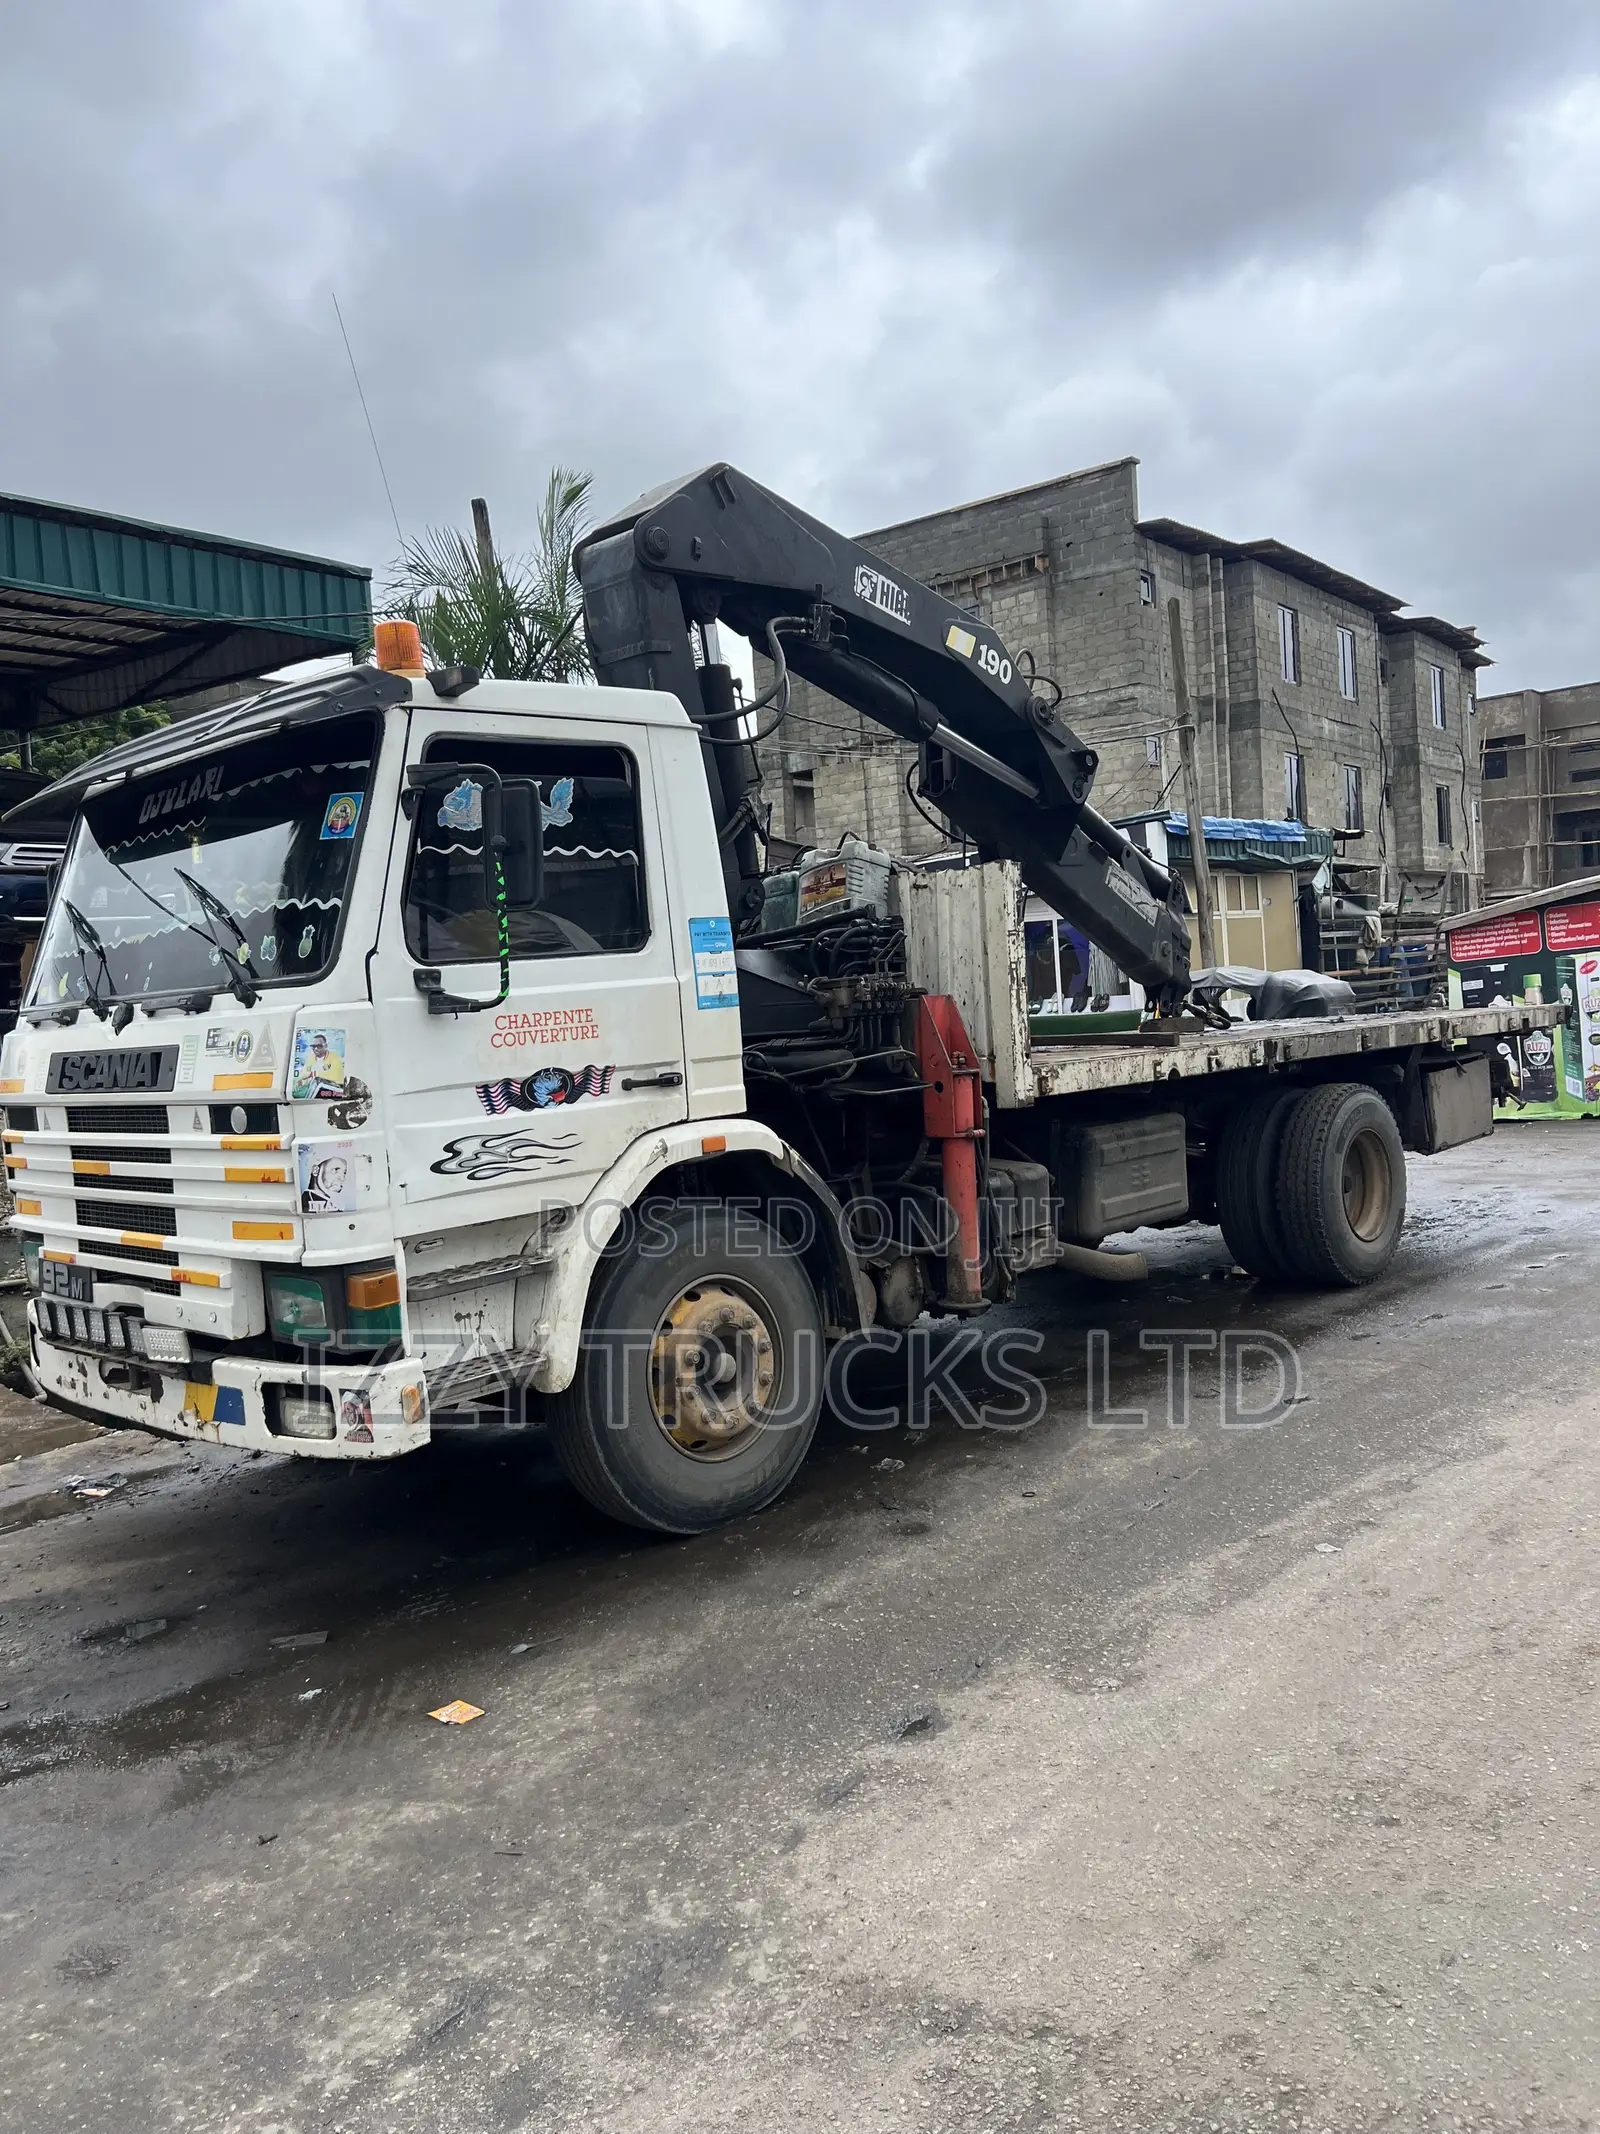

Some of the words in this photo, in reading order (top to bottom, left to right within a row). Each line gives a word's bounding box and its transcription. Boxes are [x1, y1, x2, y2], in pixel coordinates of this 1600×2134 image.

[977, 645, 1012, 684] 190
[495, 1008, 593, 1030] CHARPENTE
[491, 1025, 599, 1048] COUVERTURE
[1526, 1041, 1548, 1052] RUZU
[62, 1051, 155, 1090] SCANIA
